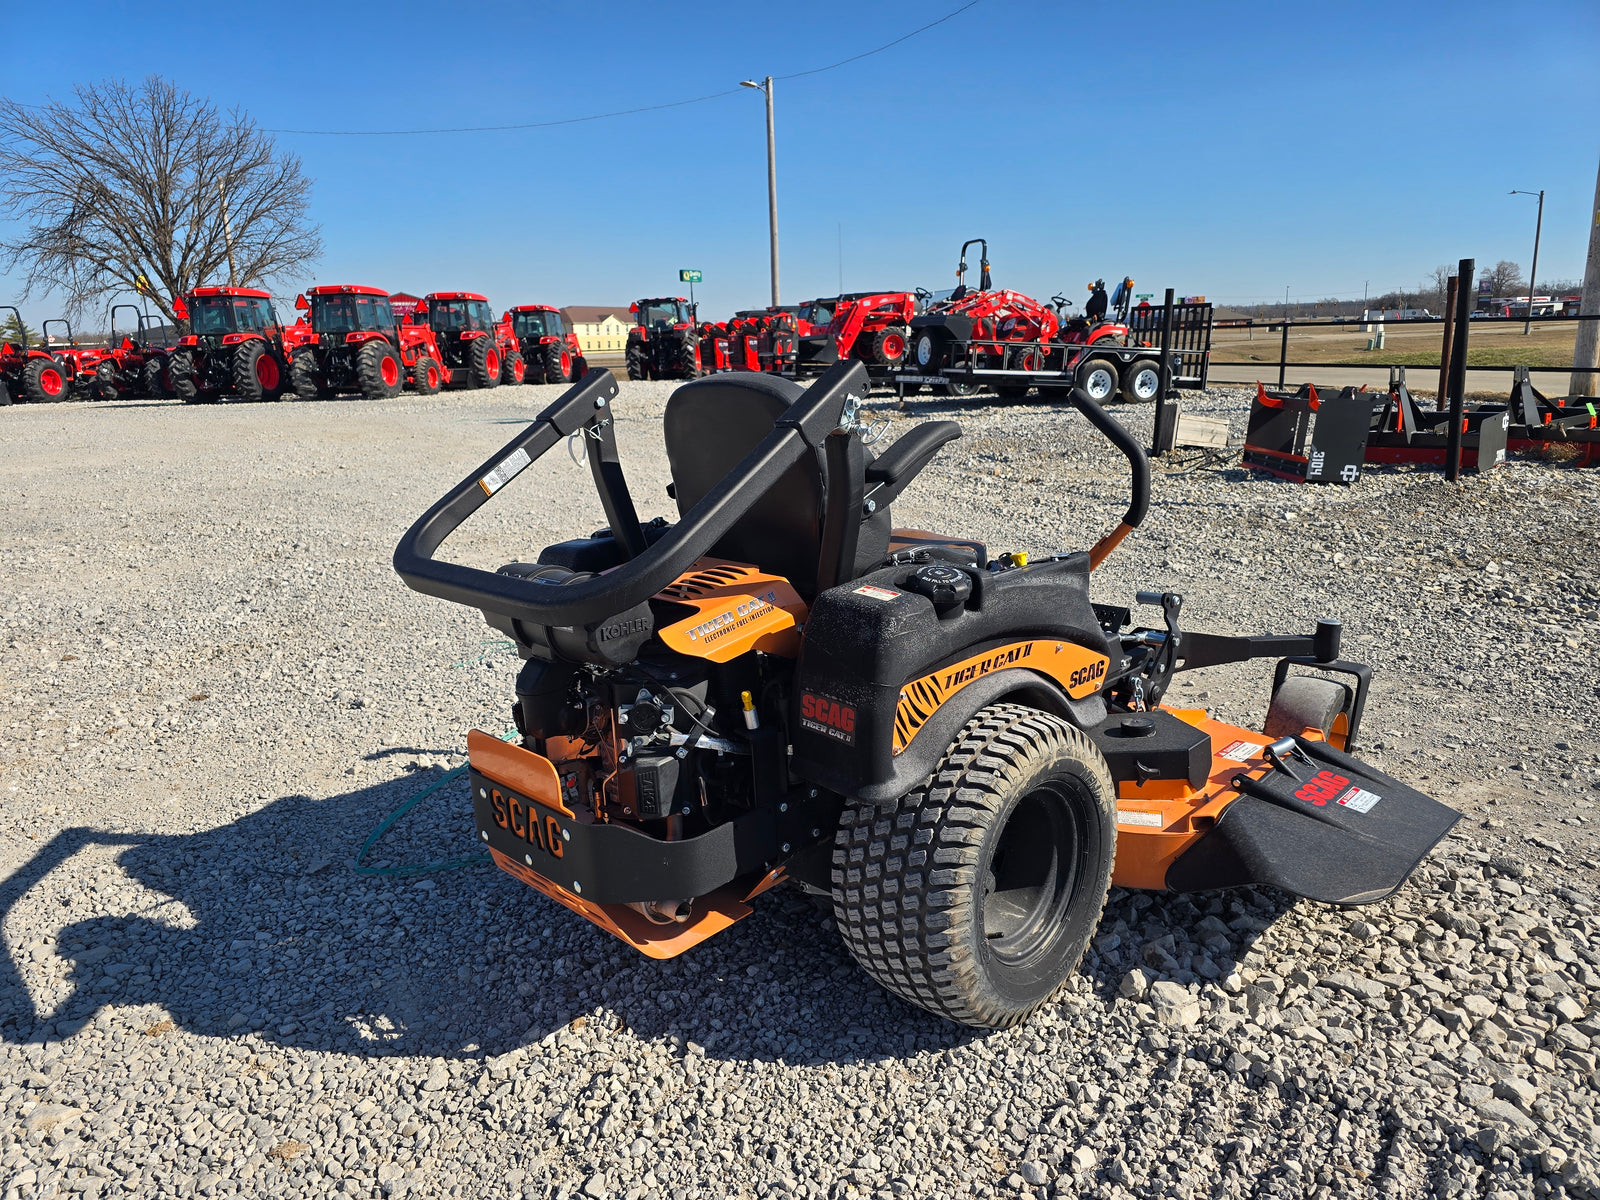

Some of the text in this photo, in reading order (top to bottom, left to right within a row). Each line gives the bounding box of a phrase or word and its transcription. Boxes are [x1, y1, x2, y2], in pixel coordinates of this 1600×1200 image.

[1310, 451, 1325, 475] 3104
[600, 617, 649, 642] KOHLER
[684, 610, 735, 641] TIGER
[736, 595, 766, 617] CAT
[704, 624, 736, 644] ELECTRONIC
[944, 658, 992, 689] TIGER
[992, 645, 1023, 670] CAT
[1069, 659, 1106, 689] SCAG
[801, 694, 855, 733] SCAG
[801, 718, 828, 733] TIGER
[828, 728, 847, 740] CAT
[1294, 770, 1351, 807] SCAG
[490, 788, 565, 859] SCAG
